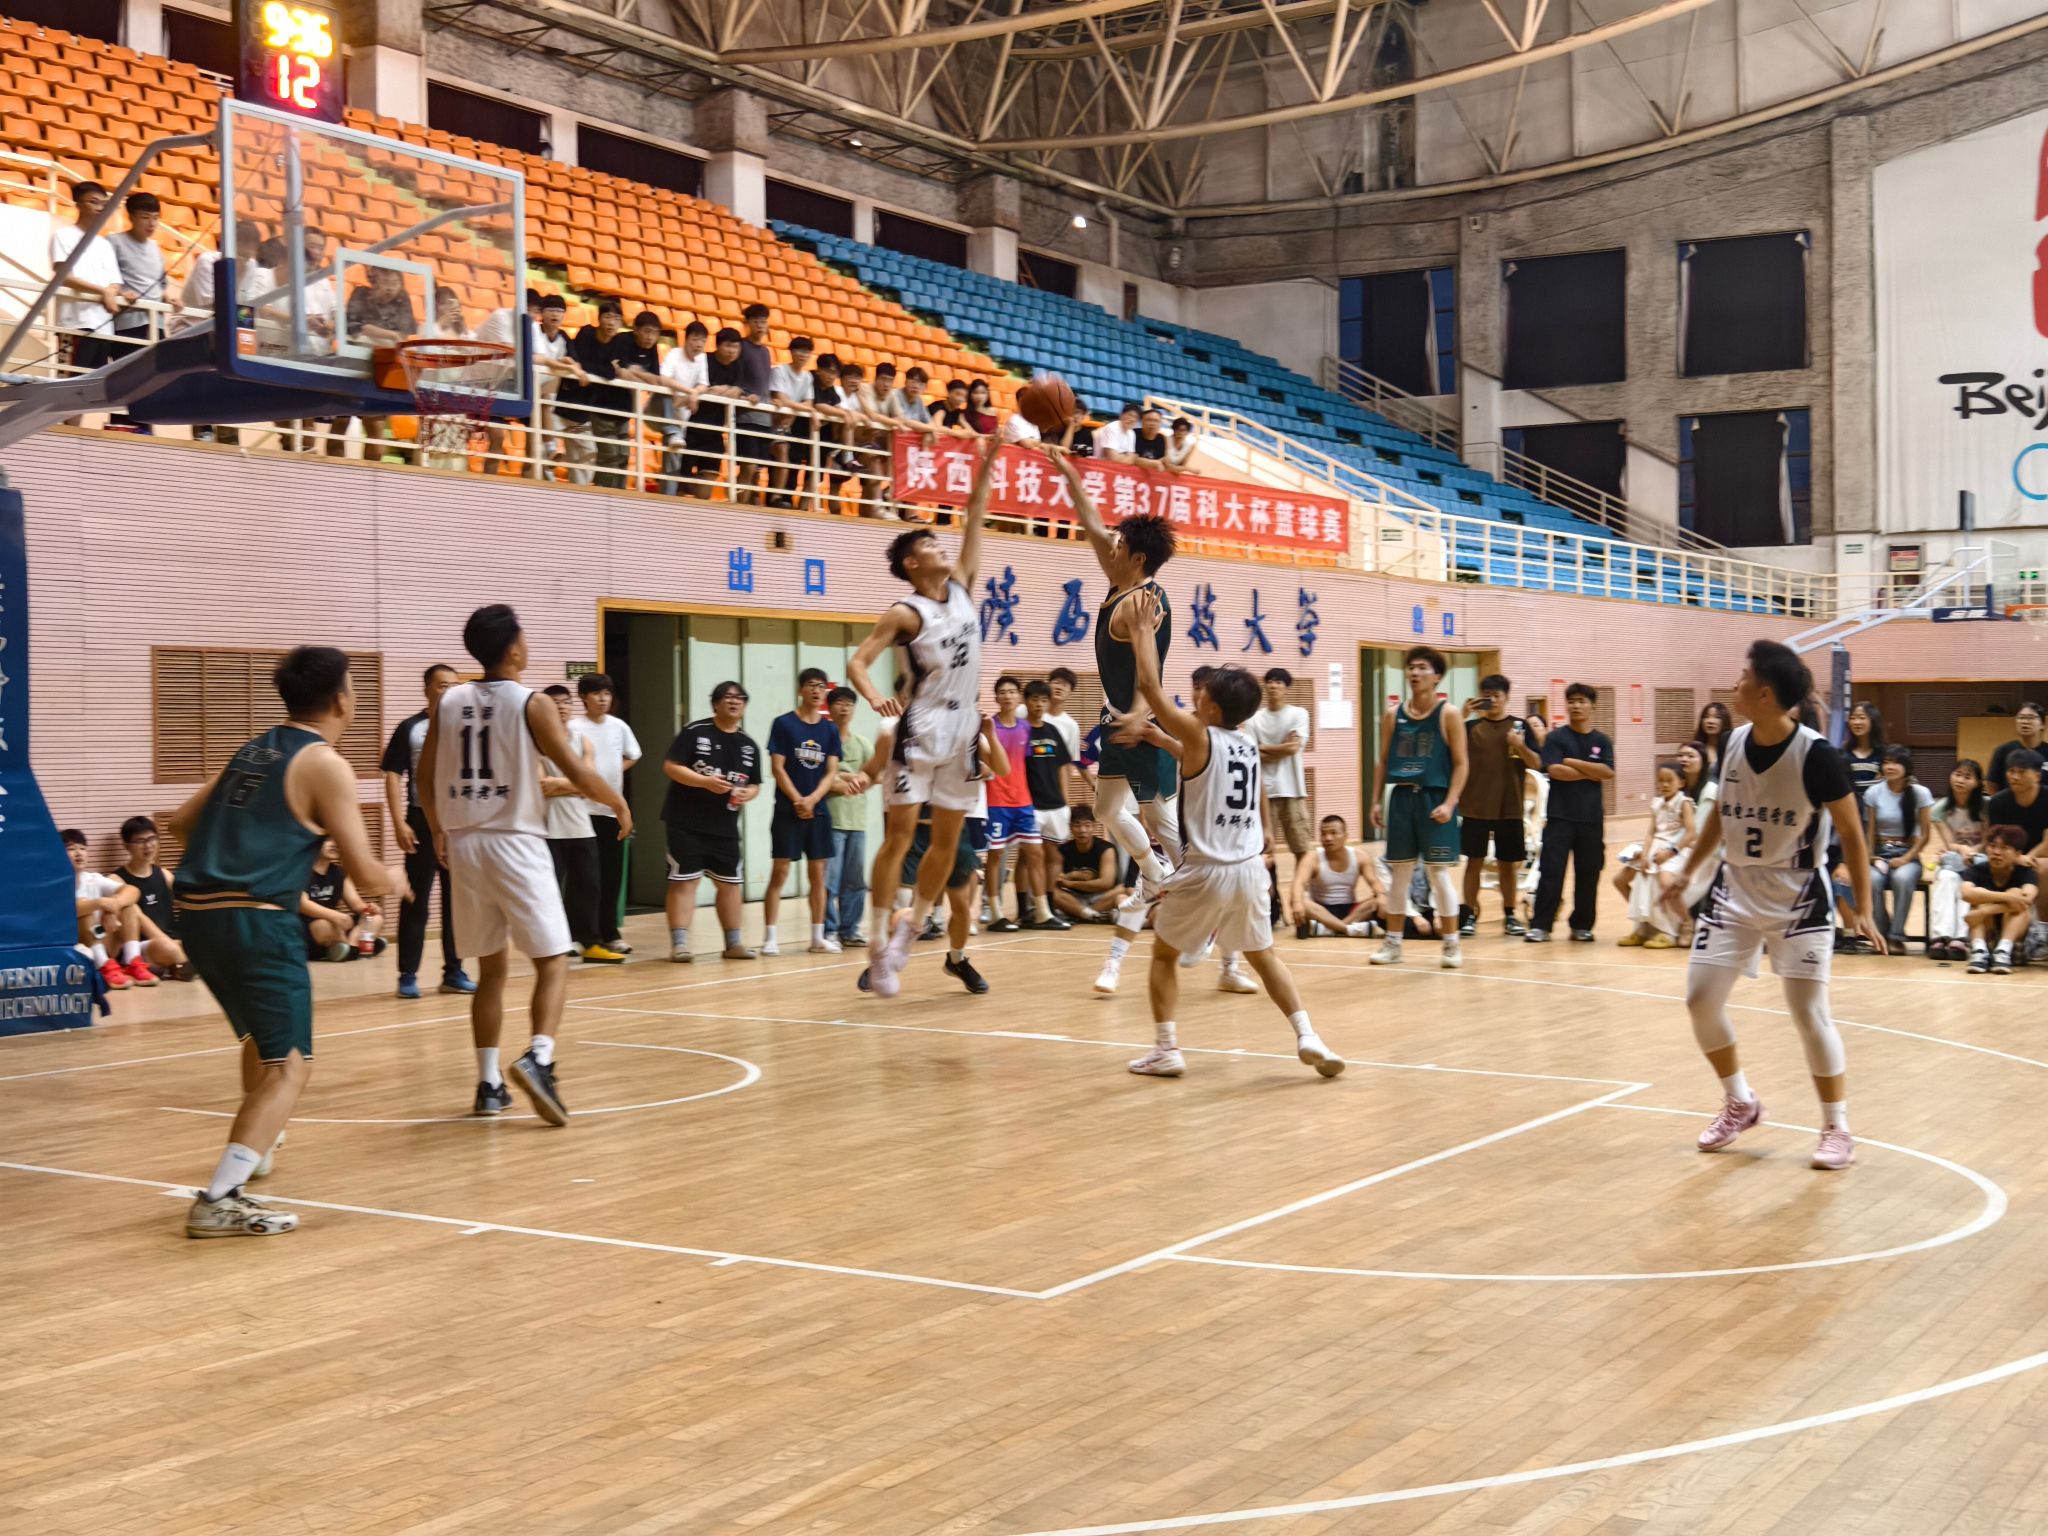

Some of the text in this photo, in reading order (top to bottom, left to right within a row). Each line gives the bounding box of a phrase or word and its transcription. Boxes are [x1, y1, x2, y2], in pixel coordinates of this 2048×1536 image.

[278, 54, 320, 108] 12
[727, 546, 827, 596] 出口
[980, 565, 1318, 657] 陕西技大学
[459, 725, 494, 779] 11
[1226, 760, 1257, 811] 31
[1745, 826, 1763, 858] 2
[1695, 927, 1710, 950] 2
